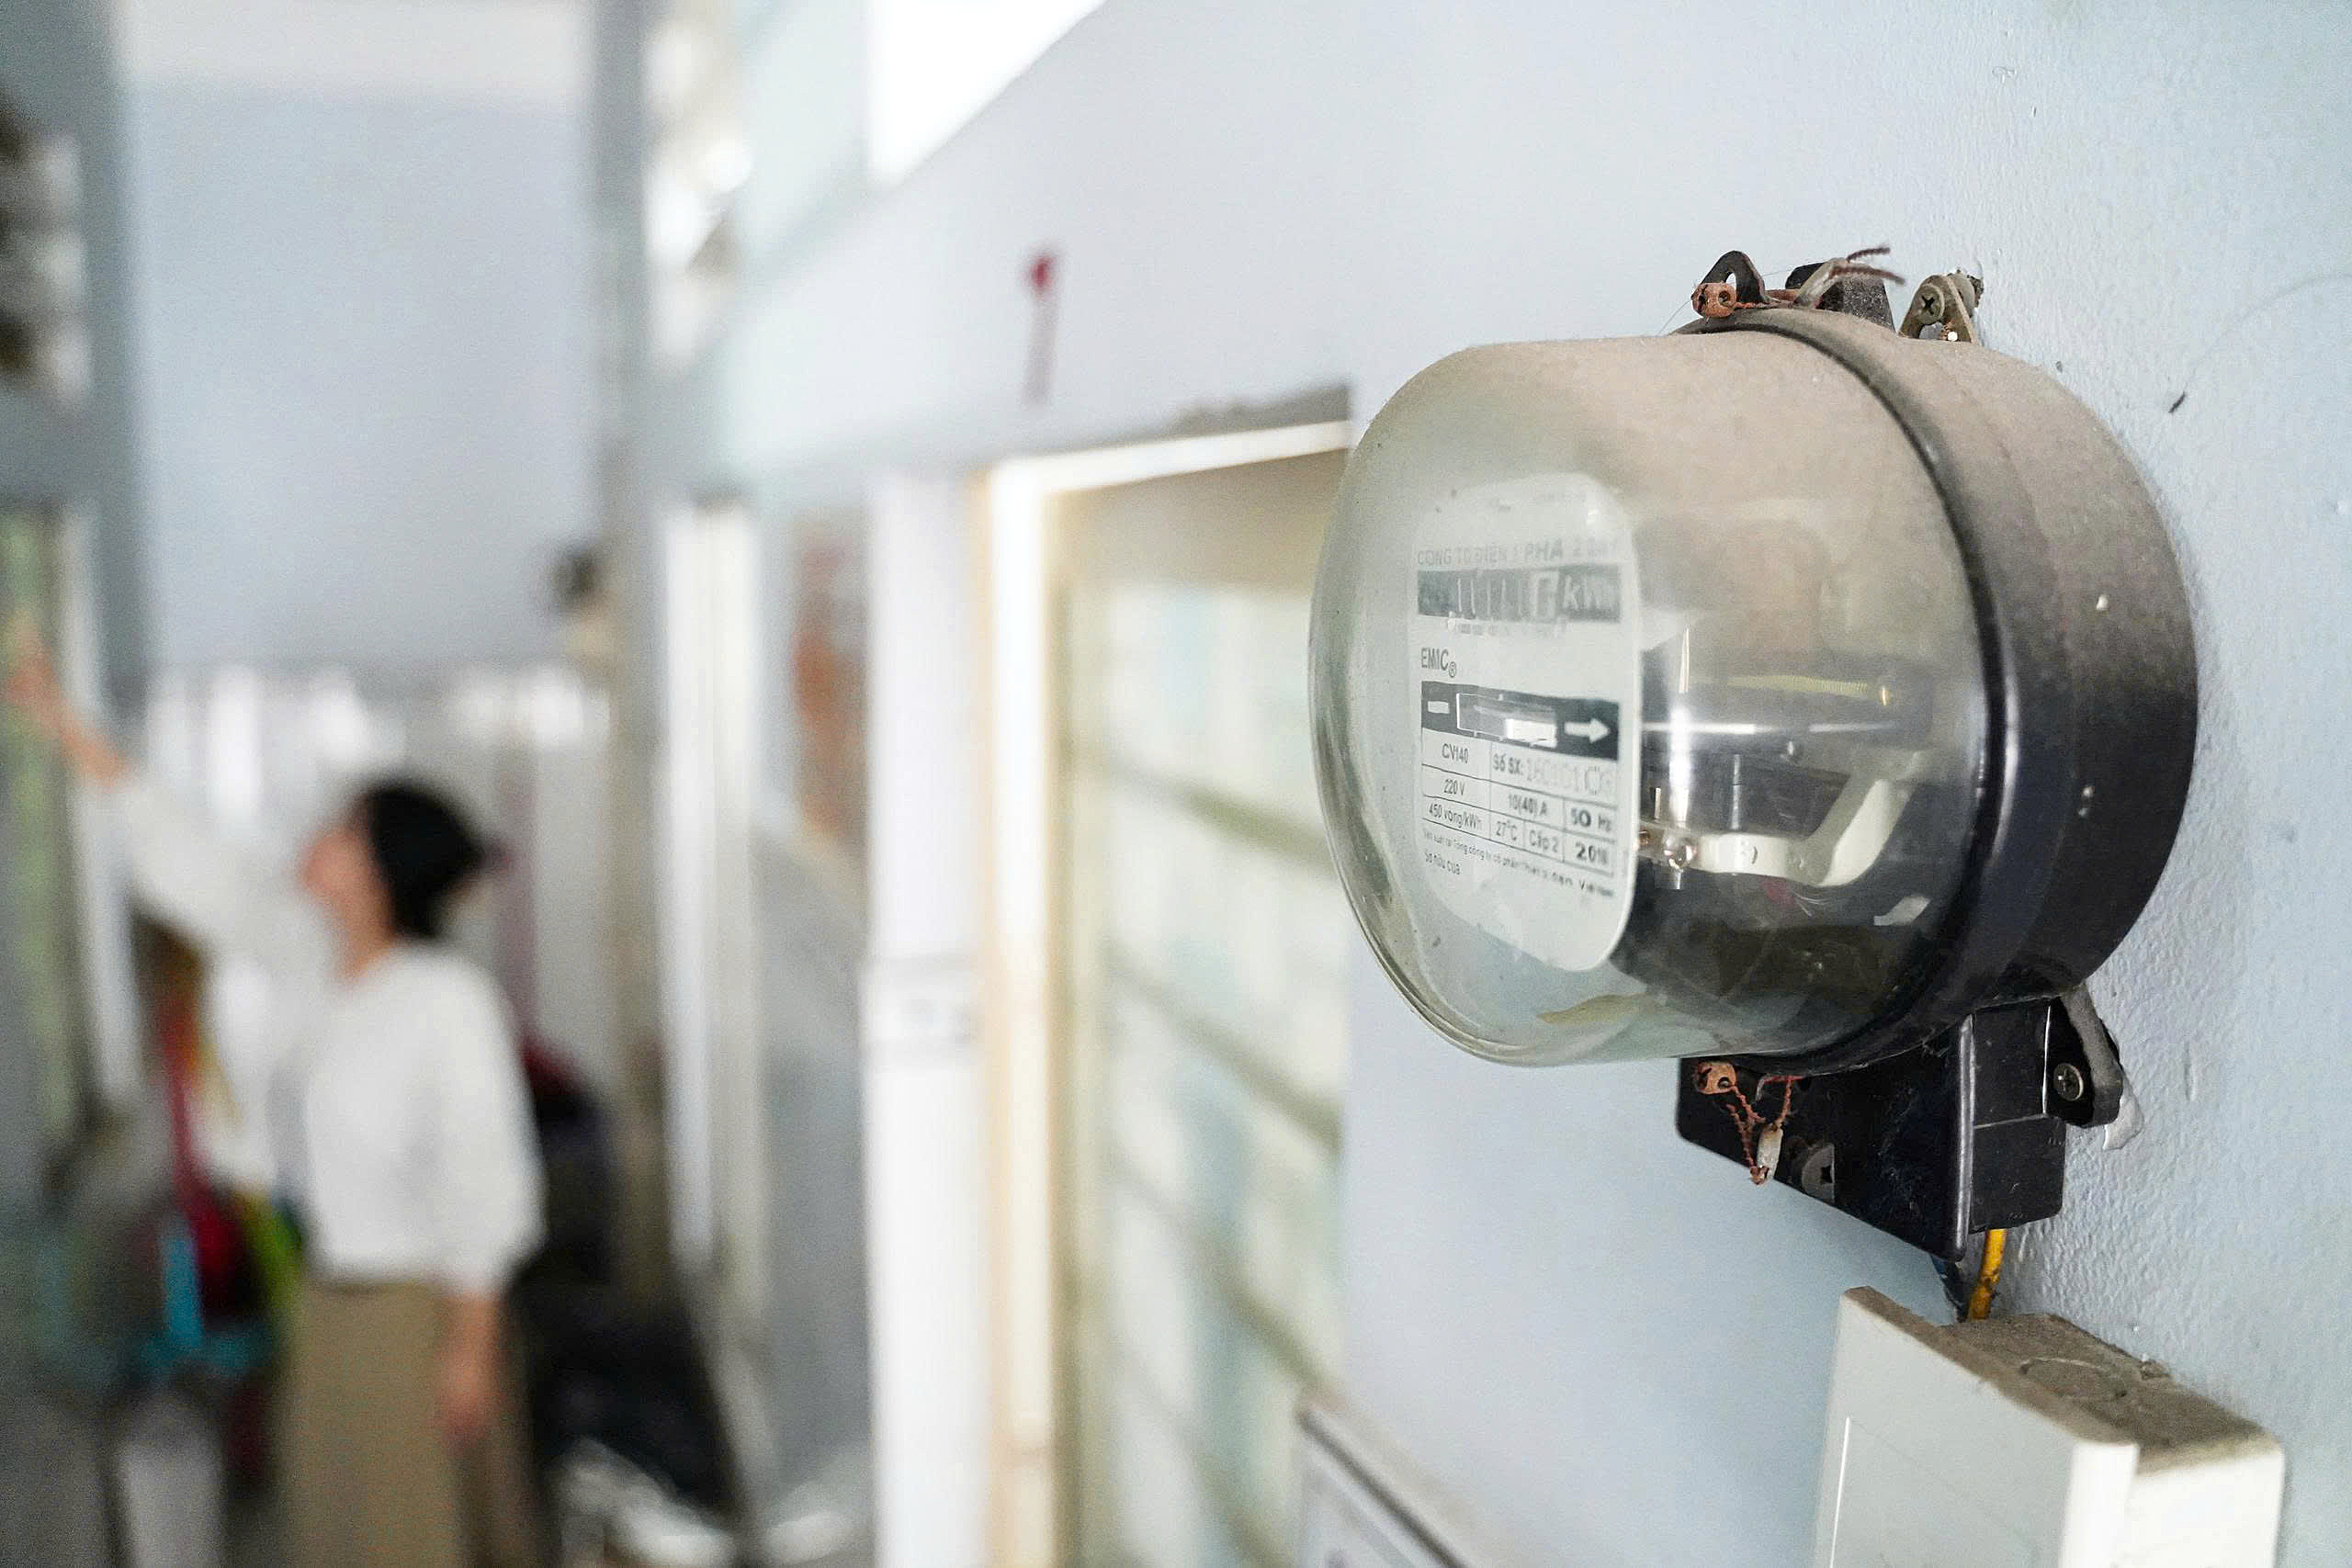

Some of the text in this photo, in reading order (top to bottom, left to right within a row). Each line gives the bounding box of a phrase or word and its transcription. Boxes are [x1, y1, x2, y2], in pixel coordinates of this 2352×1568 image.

[1442, 742, 1469, 763] CV140
[1443, 778, 1465, 795] 220 V
[1429, 803, 1442, 818] 450
[1540, 801, 1548, 817] A
[1571, 807, 1591, 827] 50
